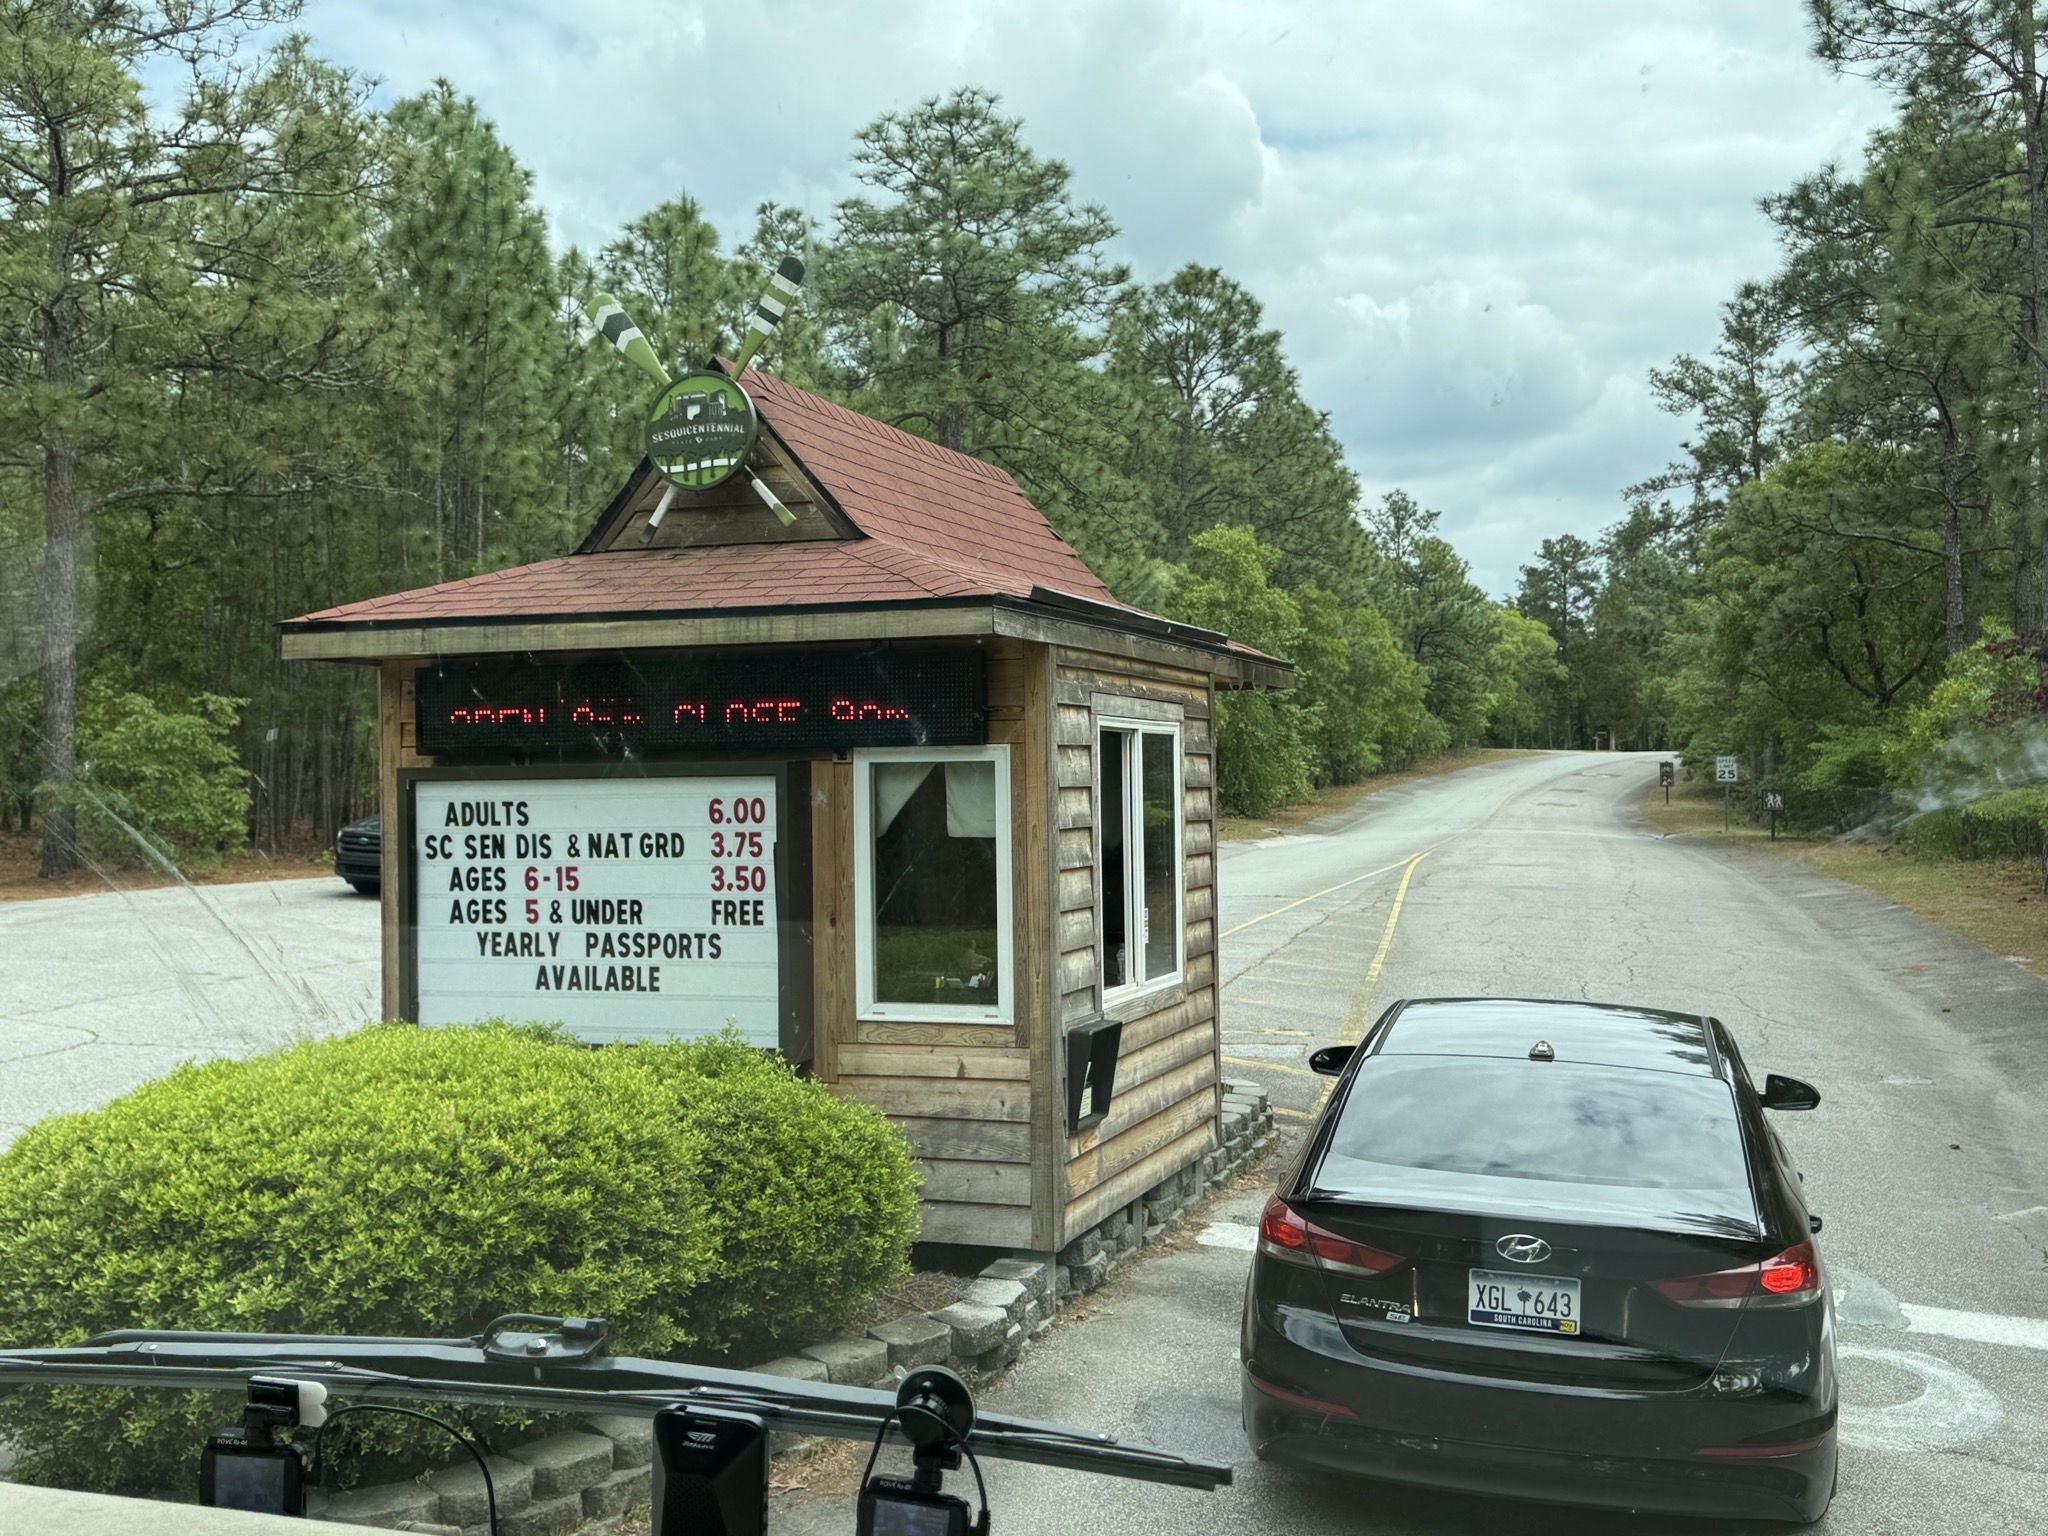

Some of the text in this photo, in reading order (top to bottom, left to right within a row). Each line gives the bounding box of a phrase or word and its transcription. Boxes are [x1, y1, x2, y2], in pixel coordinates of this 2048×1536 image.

[651, 423, 745, 443] SESQUICENTENNIAL
[1718, 770, 1735, 779] 25
[445, 798, 766, 827] ADULTS 6.00
[425, 831, 763, 859] SC SEN DIS & NAT GRD 3.75
[449, 865, 766, 892] AGES 6-15 3.50
[449, 898, 764, 926] AGES 5 & UNDER FREE
[477, 931, 722, 959] YEARLY PASSPORTS
[535, 965, 661, 992] AVAILABLE
[1340, 1294, 1410, 1313] ELANTRA
[1476, 1283, 1571, 1318] XGL 643
[1388, 1313, 1407, 1322] SE
[1493, 1314, 1552, 1328] SOUTH CAROLINA
